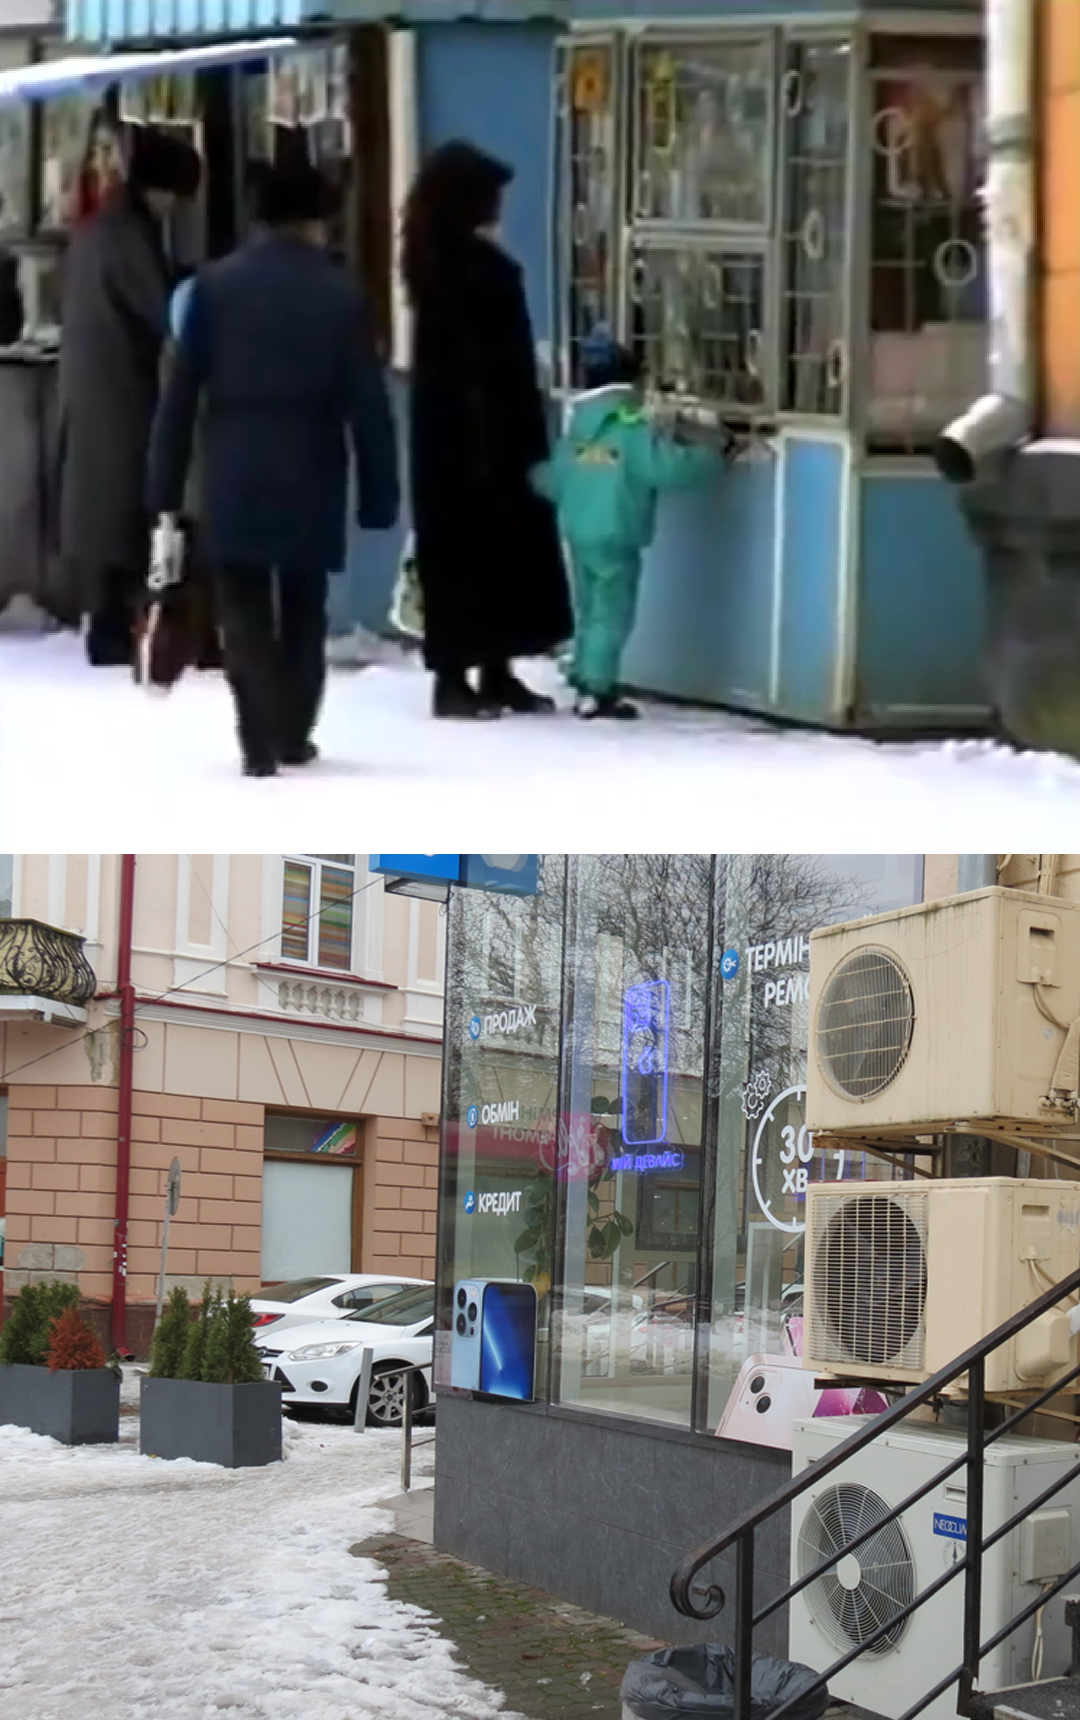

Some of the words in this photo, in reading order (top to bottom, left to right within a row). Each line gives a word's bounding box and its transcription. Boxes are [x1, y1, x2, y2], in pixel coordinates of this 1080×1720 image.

[484, 1004, 537, 1035] ПРОДАЖ
[481, 1100, 519, 1125] ОБМІН
[780, 1125, 814, 1163] 30
[634, 1151, 681, 1172] ДЕВАЙС
[781, 1168, 808, 1194] ХВ
[478, 1191, 522, 1216] КРЕДИТ
